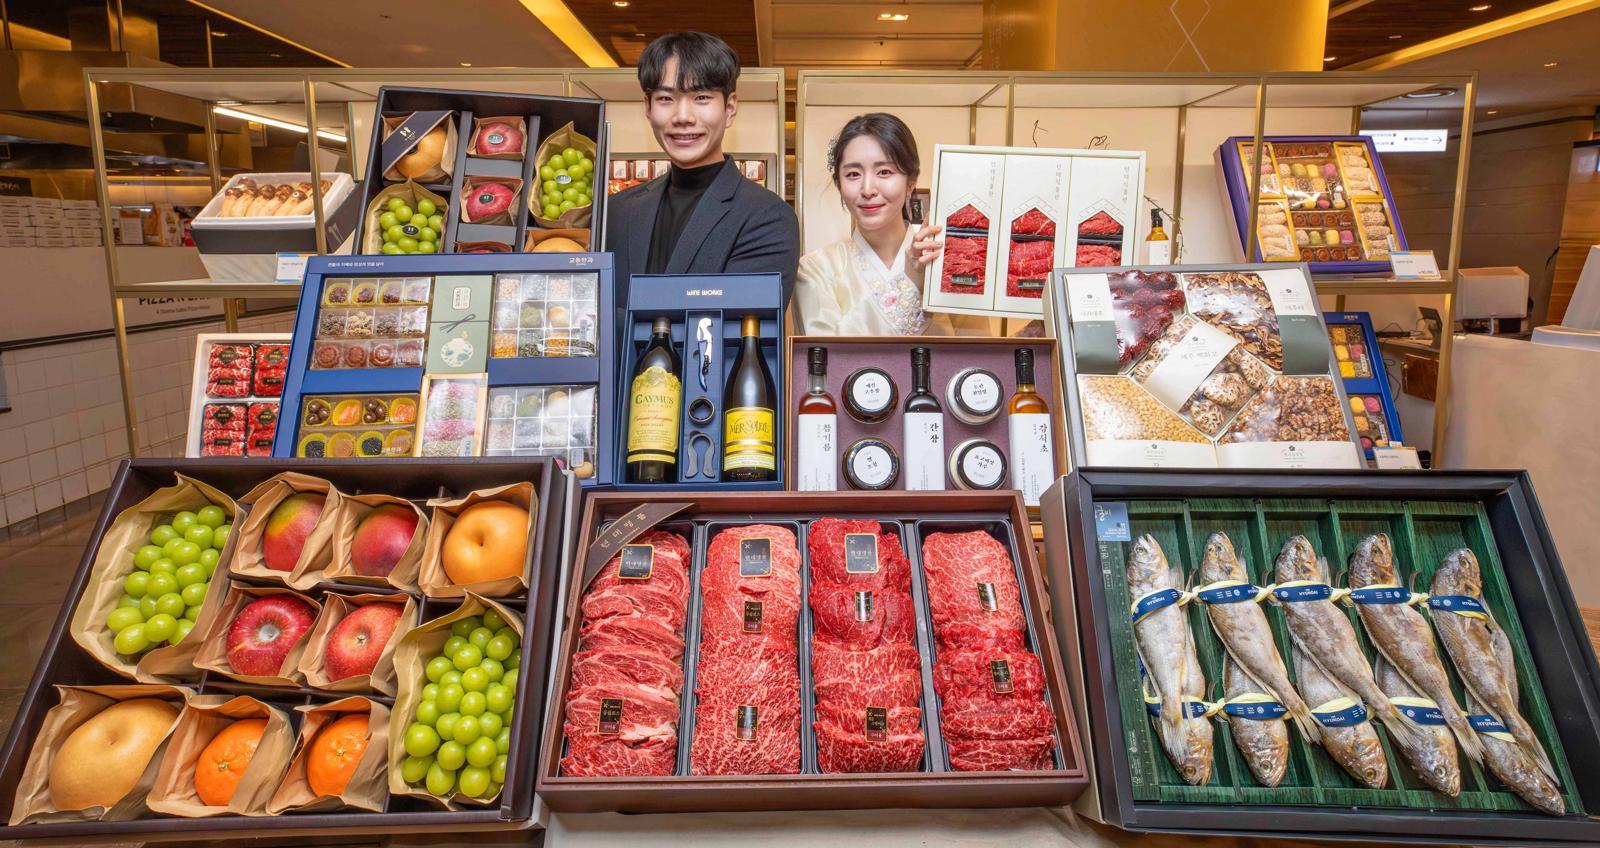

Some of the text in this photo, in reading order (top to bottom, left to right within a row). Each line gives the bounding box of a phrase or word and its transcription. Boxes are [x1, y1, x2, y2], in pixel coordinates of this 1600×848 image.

[635, 393, 674, 405] CAYMUS
[823, 424, 832, 452] 참기름
[930, 422, 940, 443] 간장
[1038, 423, 1049, 453] 감식초
